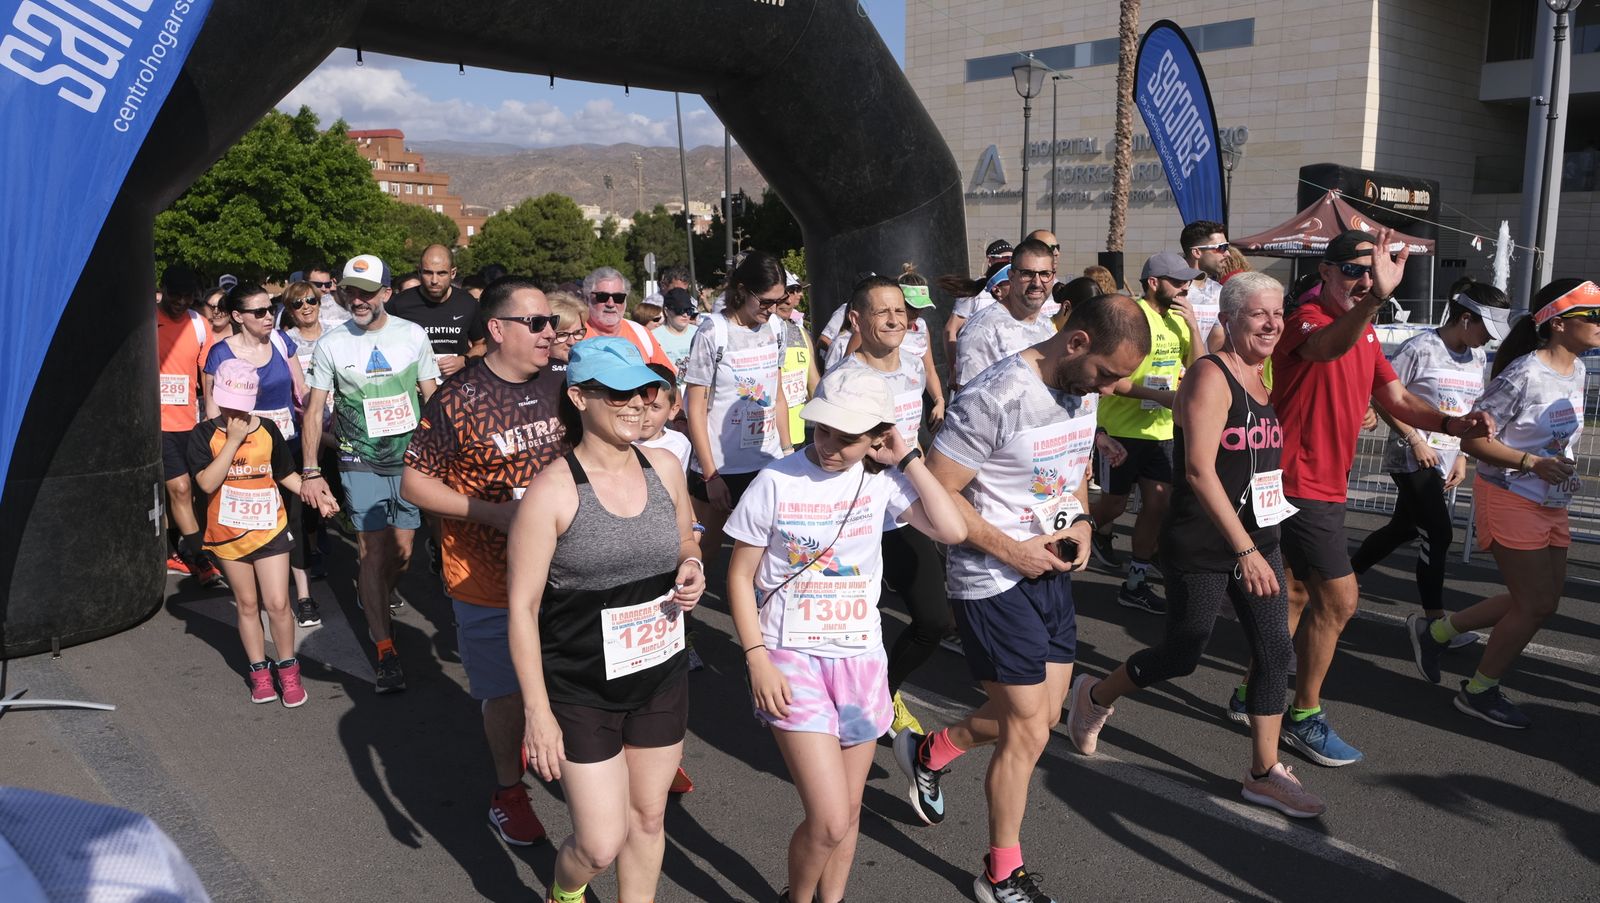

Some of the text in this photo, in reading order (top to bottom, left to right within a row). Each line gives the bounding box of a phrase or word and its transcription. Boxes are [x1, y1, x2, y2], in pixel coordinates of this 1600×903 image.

[374, 405, 411, 422] 1292
[528, 438, 543, 448] DEL
[228, 500, 271, 515] 1301
[798, 599, 868, 621] 1300
[822, 623, 847, 631] JIMENA
